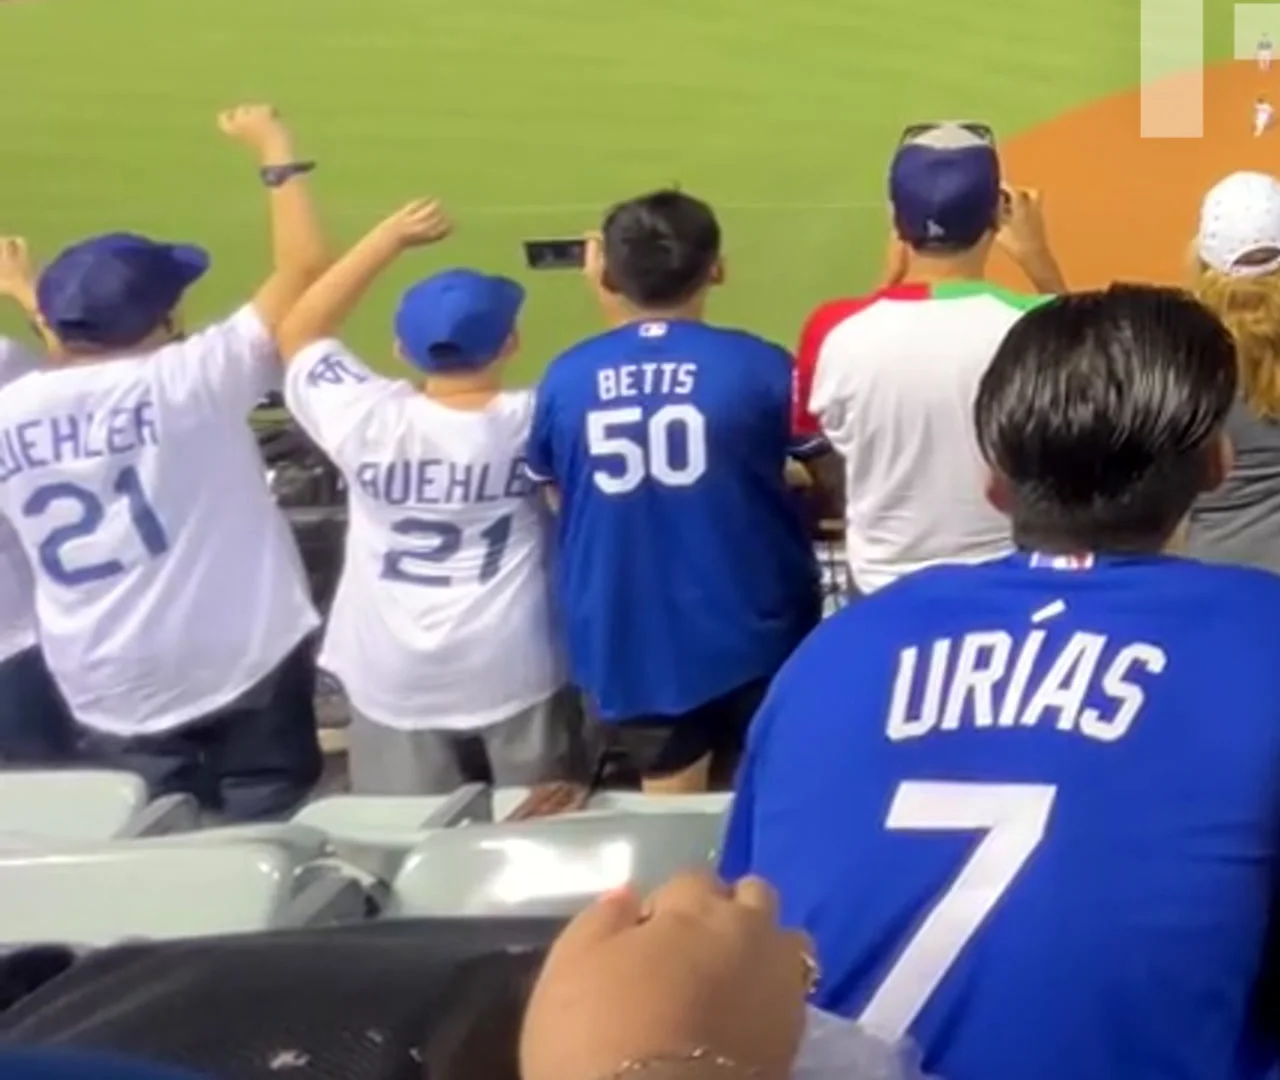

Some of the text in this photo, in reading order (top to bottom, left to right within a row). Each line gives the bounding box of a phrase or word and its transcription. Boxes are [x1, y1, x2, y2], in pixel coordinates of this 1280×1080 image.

[597, 362, 698, 401] BETTS
[0, 401, 158, 483] UEHLER
[586, 403, 707, 495] 50
[22, 465, 168, 587] 21
[379, 508, 514, 588] 21
[885, 599, 1168, 742] URÍAS
[857, 779, 1058, 1044] 7
